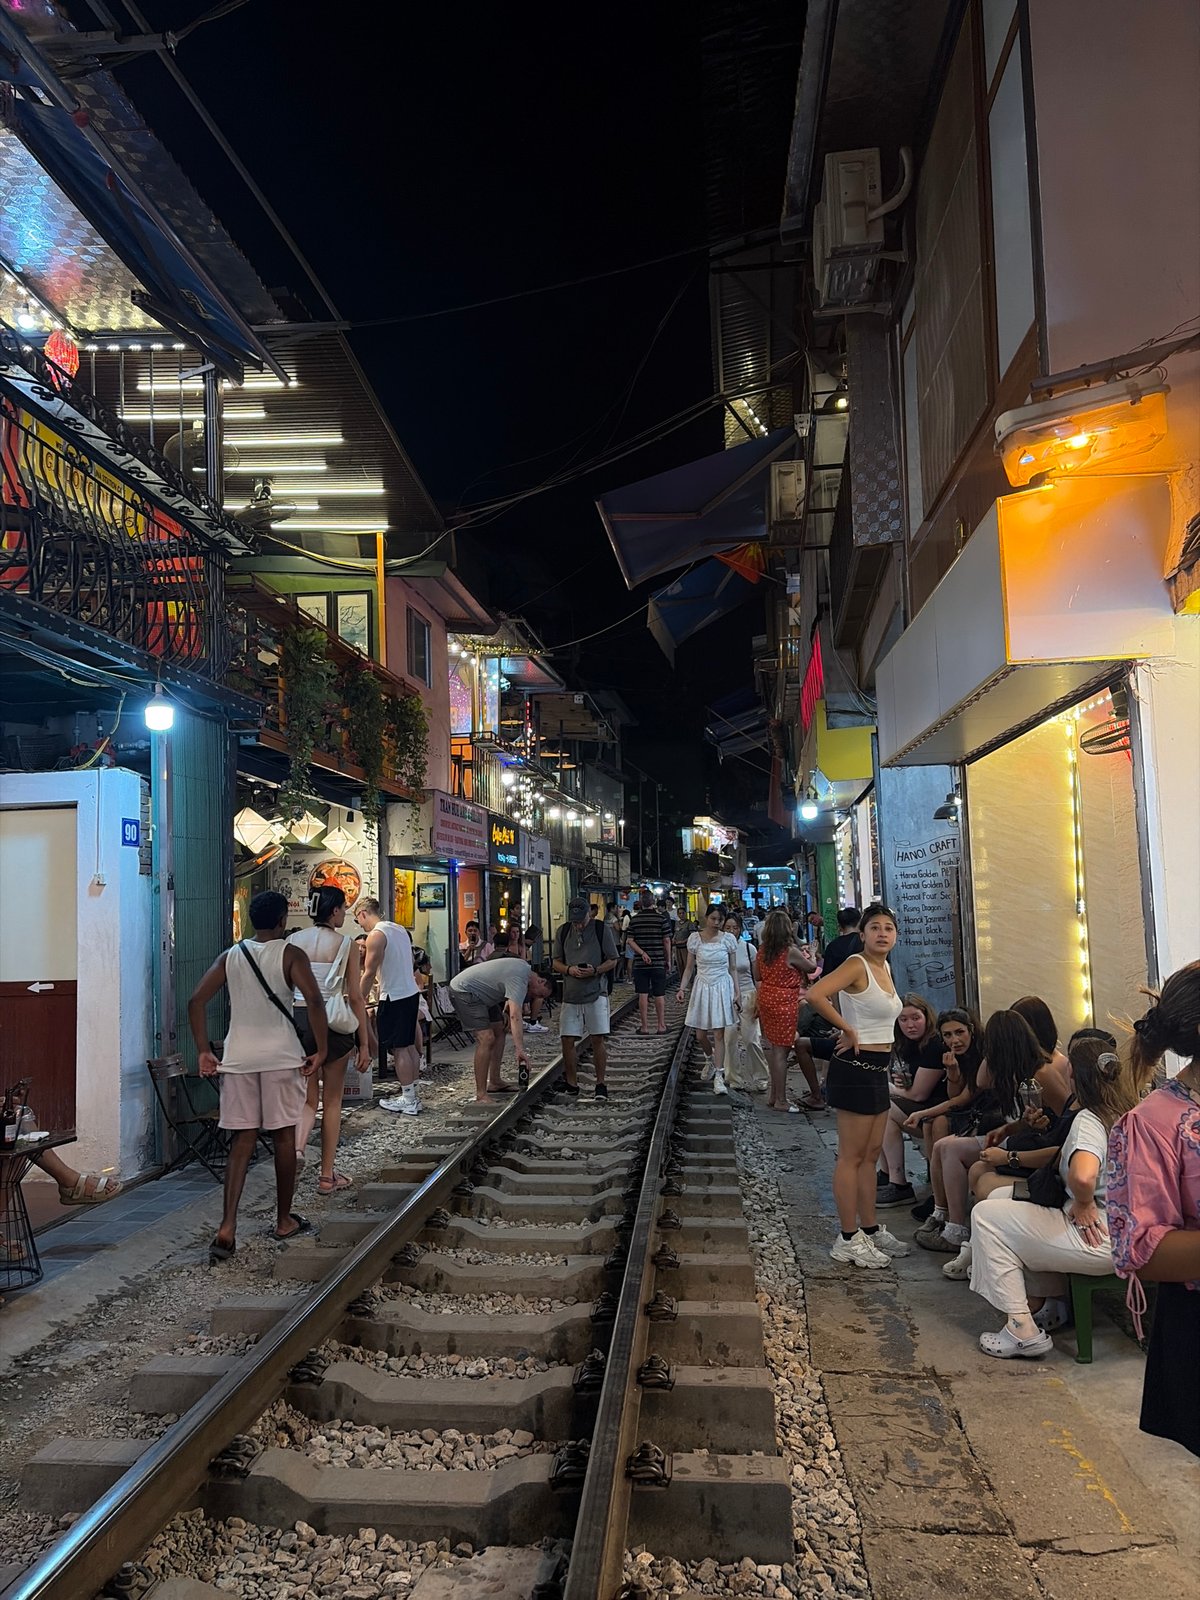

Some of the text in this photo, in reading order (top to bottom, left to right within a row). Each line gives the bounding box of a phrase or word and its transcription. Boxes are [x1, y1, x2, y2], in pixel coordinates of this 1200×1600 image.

[125, 823, 137, 842] 90
[896, 838, 957, 861] HANOI CRAFT
[900, 871, 918, 879] Hanoi
[918, 869, 939, 878] Golden
[901, 881, 920, 890] Hanoi
[922, 880, 943, 889] Golden
[902, 892, 921, 901] Hanoi
[922, 892, 938, 900] Four
[903, 904, 921, 914] Rising
[904, 915, 923, 924] Hanoi
[924, 915, 946, 926] Jasmine
[904, 926, 922, 935] Hanoi
[904, 938, 922, 946] Hanoi
